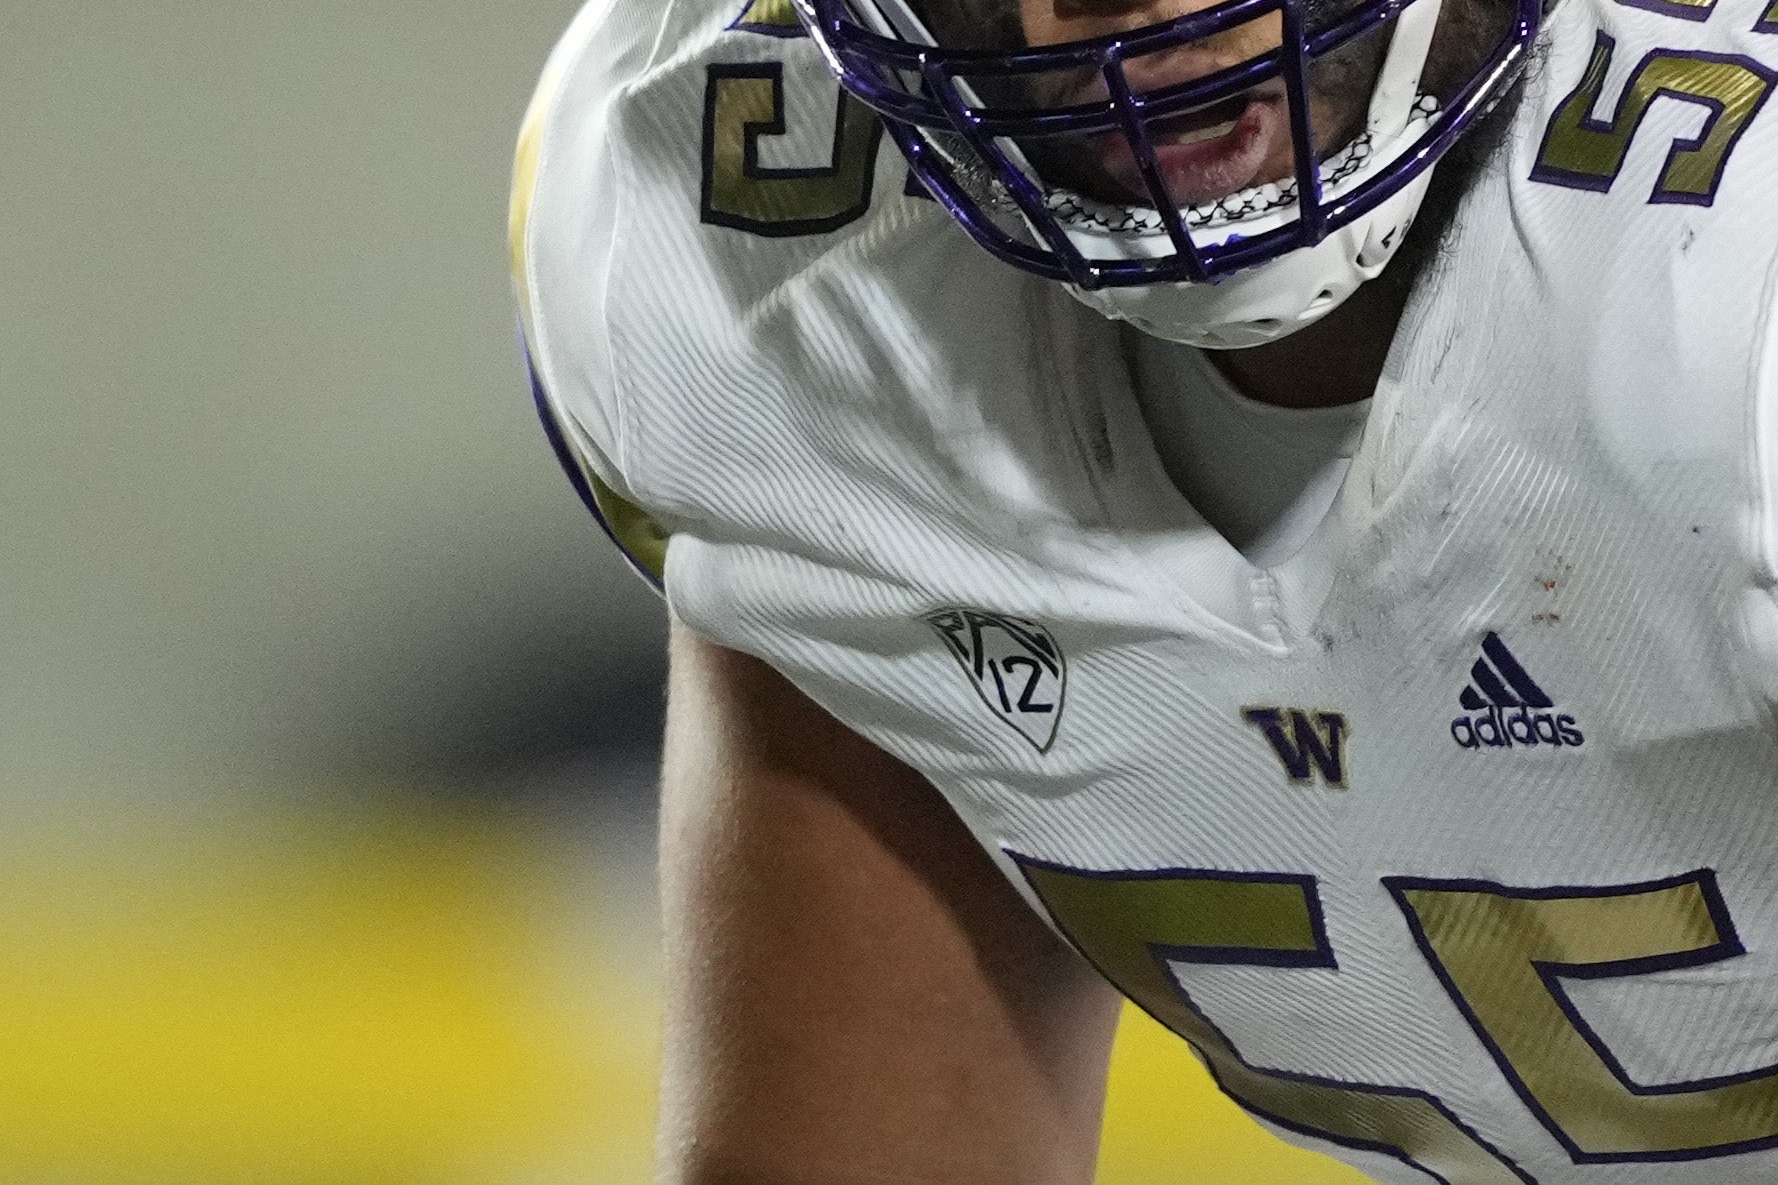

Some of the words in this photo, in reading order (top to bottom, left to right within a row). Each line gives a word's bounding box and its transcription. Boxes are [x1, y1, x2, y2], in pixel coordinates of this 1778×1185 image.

[987, 654, 1055, 714] 12
[1239, 703, 1352, 791] W
[1450, 701, 1586, 749] adidas
